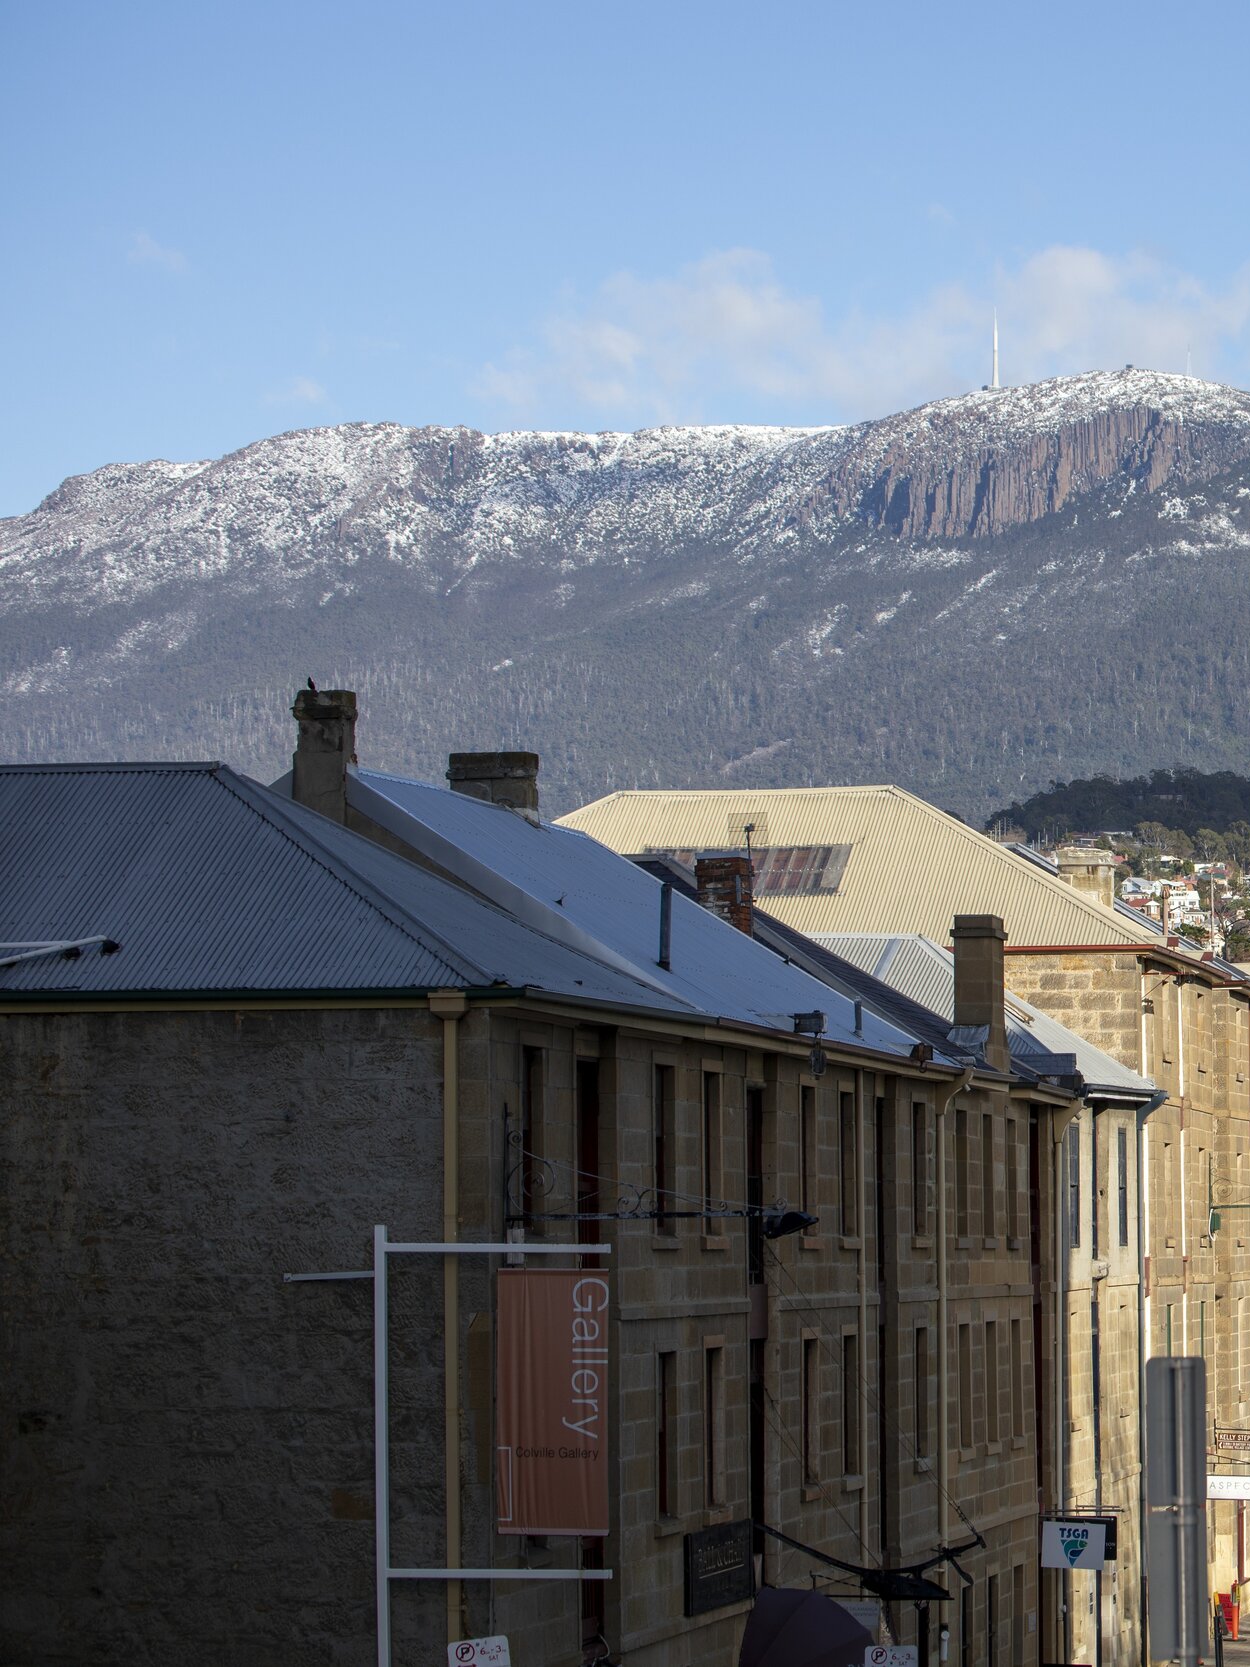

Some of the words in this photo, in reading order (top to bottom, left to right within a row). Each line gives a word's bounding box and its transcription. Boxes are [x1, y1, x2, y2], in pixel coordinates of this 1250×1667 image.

[561, 1277, 609, 1439] Gallery
[1219, 1433, 1236, 1441] KELLY
[515, 1446, 554, 1458] Colville
[558, 1447, 599, 1461] Gallery
[1059, 1528, 1089, 1539] TSGA
